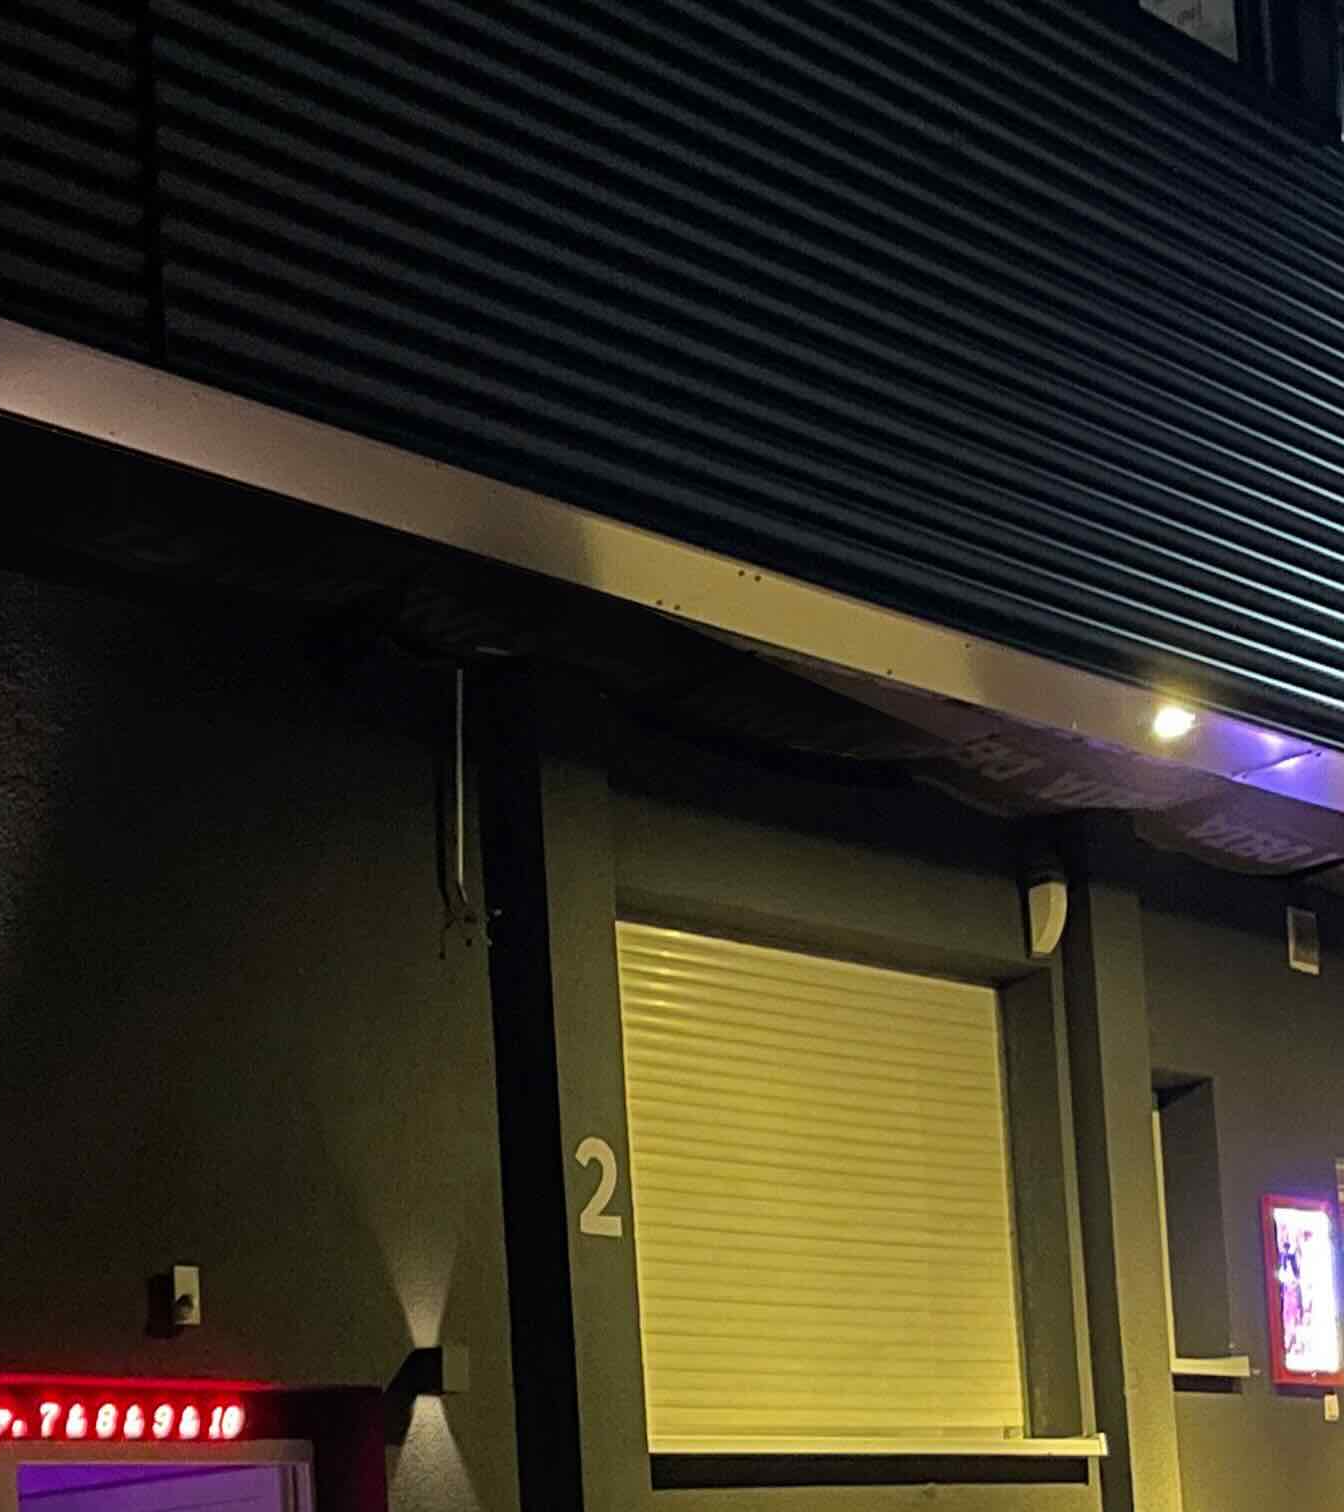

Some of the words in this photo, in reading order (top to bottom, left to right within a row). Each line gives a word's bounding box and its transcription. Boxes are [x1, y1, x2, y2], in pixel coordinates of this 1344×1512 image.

[575, 1136, 623, 1237] 2
[39, 1402, 61, 1438] 7
[96, 1403, 118, 1439] 8
[152, 1403, 174, 1439] 9
[208, 1405, 244, 1439] 10
